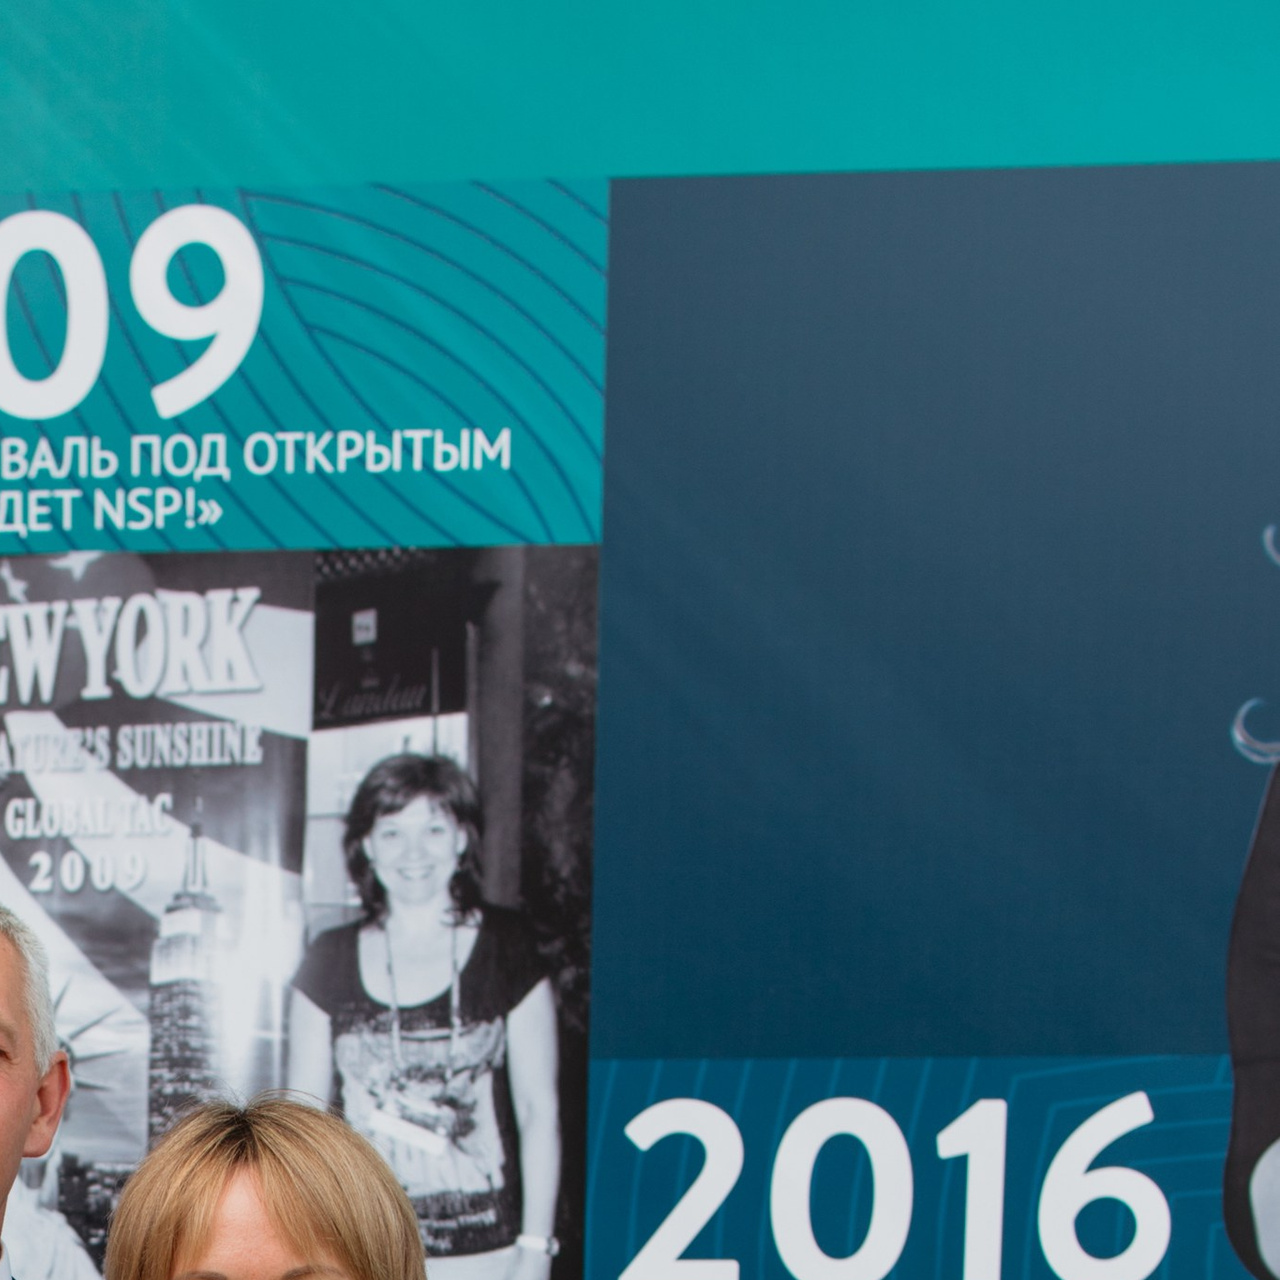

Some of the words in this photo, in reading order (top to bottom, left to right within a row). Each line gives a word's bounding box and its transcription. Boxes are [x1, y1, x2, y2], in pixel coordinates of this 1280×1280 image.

[131, 433, 230, 481] ПОД
[244, 428, 511, 474] ОТКРЫТЫМ
[94, 487, 222, 529] NSP!»
[70, 588, 263, 699] YORK
[117, 721, 264, 768] SUNSHINE
[28, 850, 147, 893] 2009
